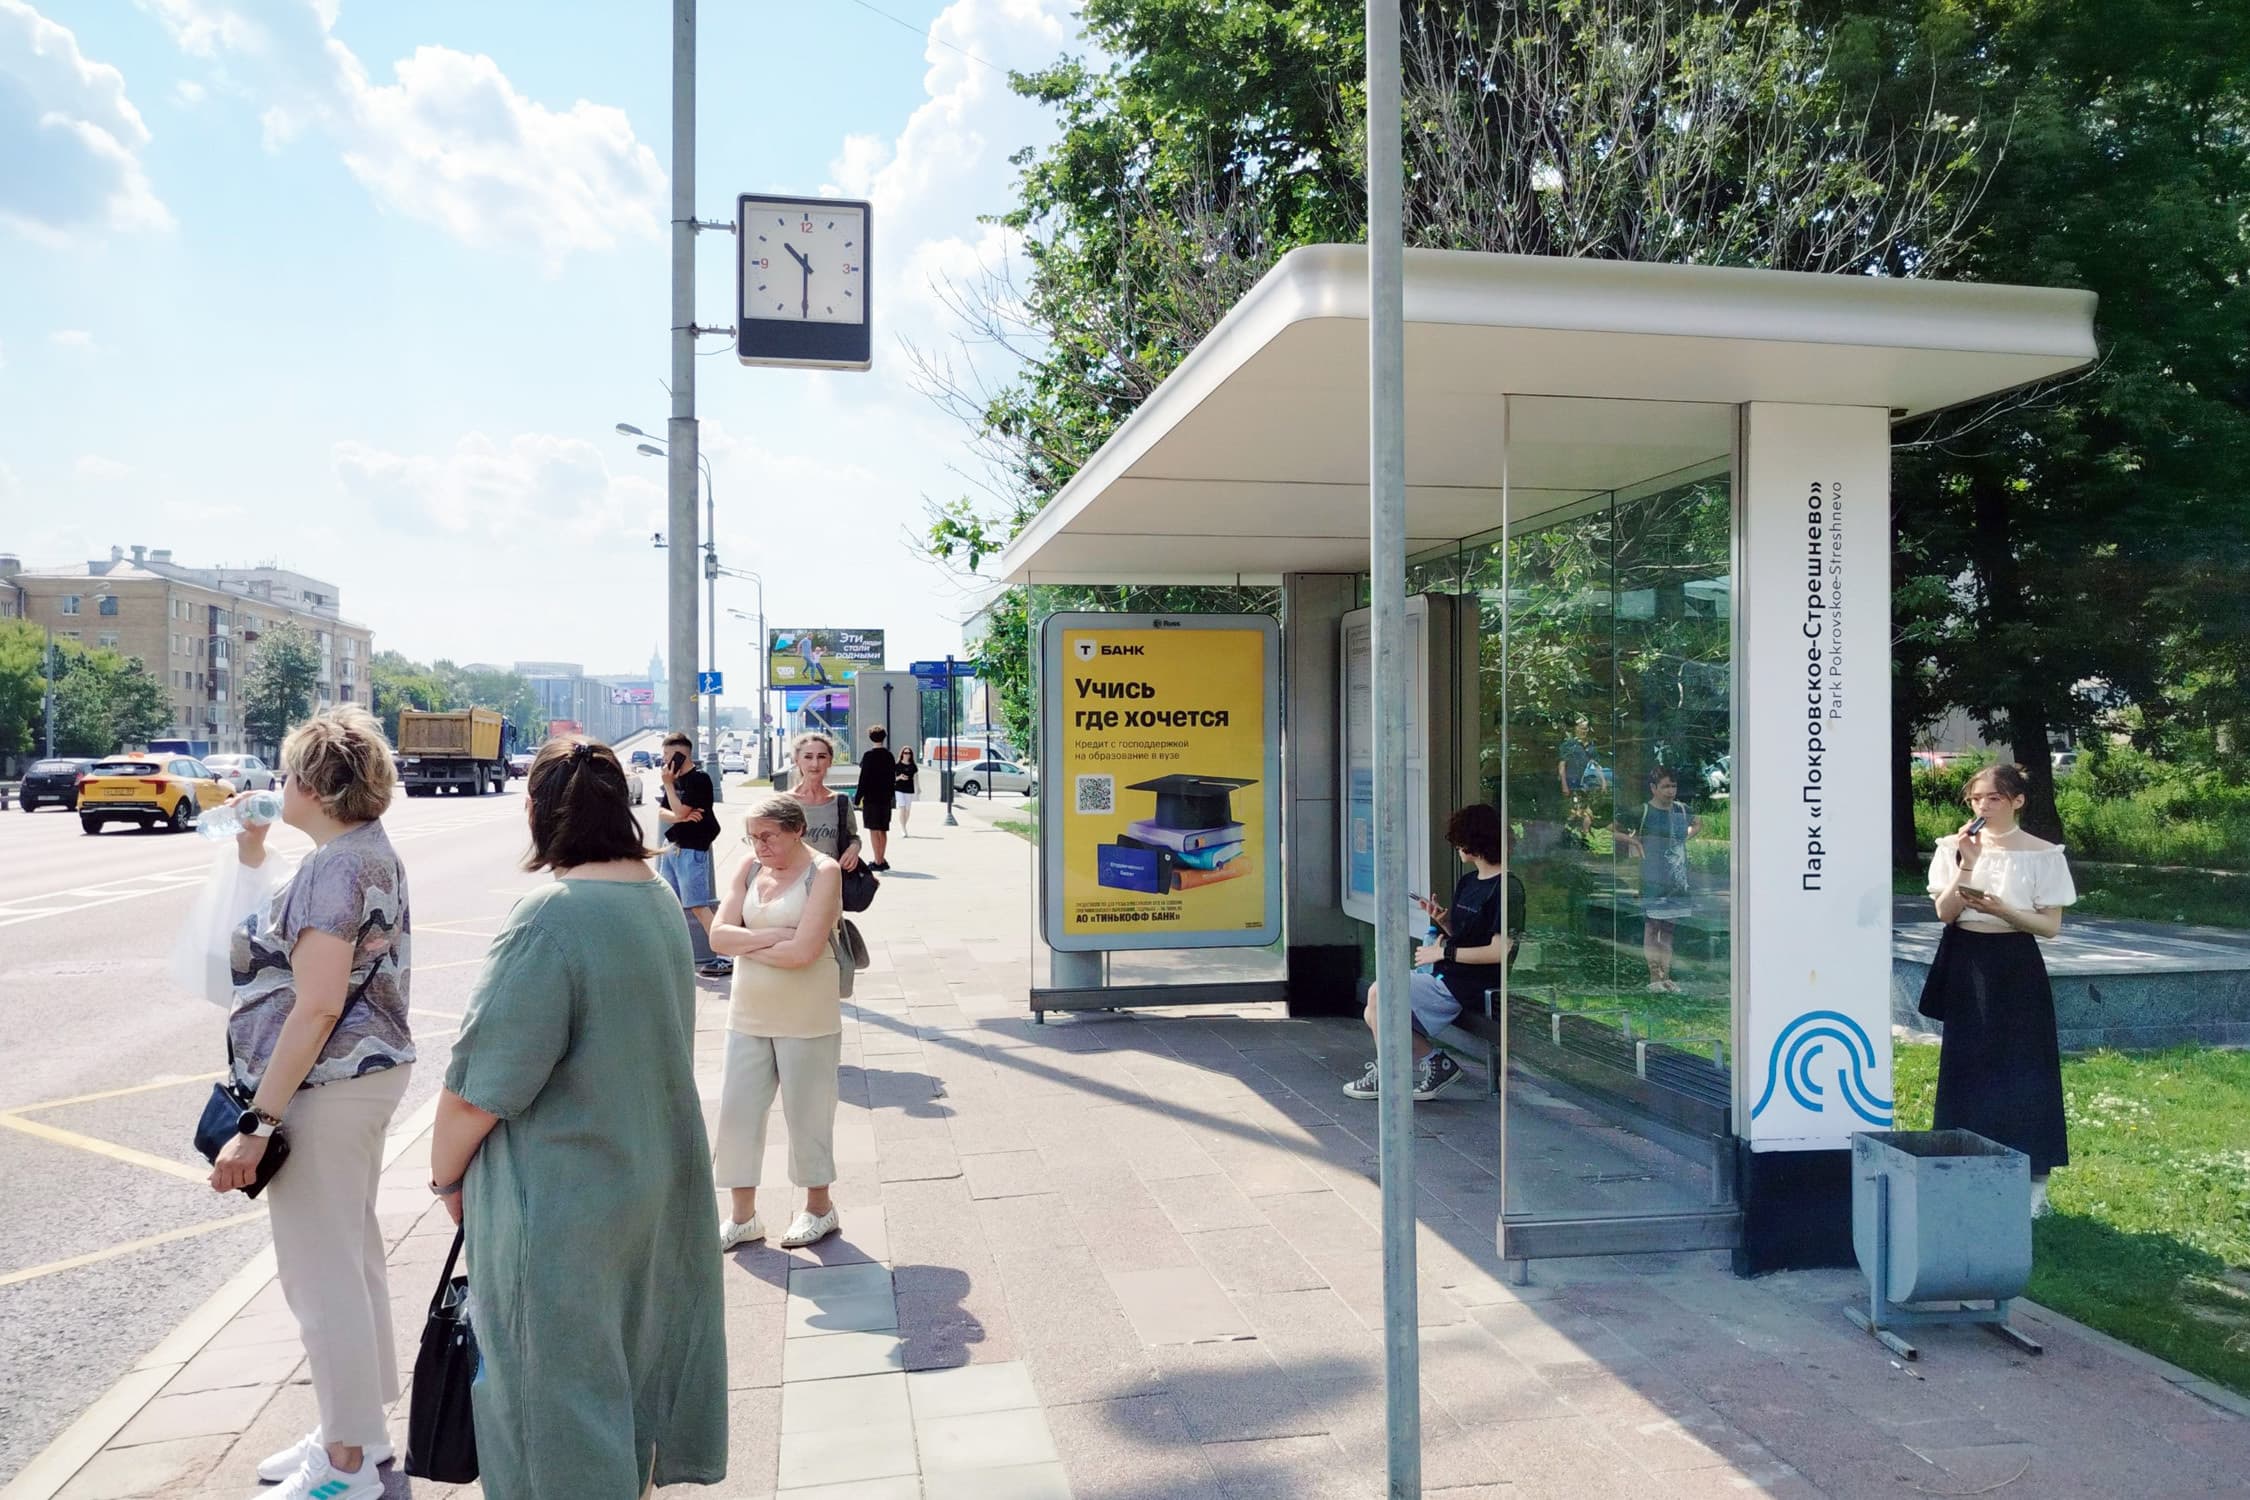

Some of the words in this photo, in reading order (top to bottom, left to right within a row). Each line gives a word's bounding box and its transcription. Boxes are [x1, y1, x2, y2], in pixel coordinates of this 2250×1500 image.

[800, 222, 813, 233] 12
[760, 258, 769, 269] 9
[842, 264, 851, 274] 3
[1829, 481, 1842, 677] Pokrovskoe-Streshnevo
[840, 632, 863, 643] Эти
[1101, 645, 1145, 655] БАНК
[1803, 481, 1826, 818] «Покровское-Стрешнево»
[836, 652, 881, 660] родными
[1075, 678, 1156, 699] Учись
[1829, 680, 1842, 719] Park
[1075, 710, 1119, 731] где
[1124, 710, 1229, 728] хочется
[1075, 740, 1108, 749] Кредит
[1118, 739, 1189, 749] господдержкой
[1075, 752, 1086, 760] на
[1088, 750, 1149, 761] образование
[1151, 752, 1157, 760] в
[1159, 752, 1180, 761] вузе
[1803, 825, 1826, 891] Парк
[1076, 914, 1088, 923] АО
[1090, 912, 1149, 922] «ТИНЬКОФФ
[1151, 911, 1180, 921] БАНК»
